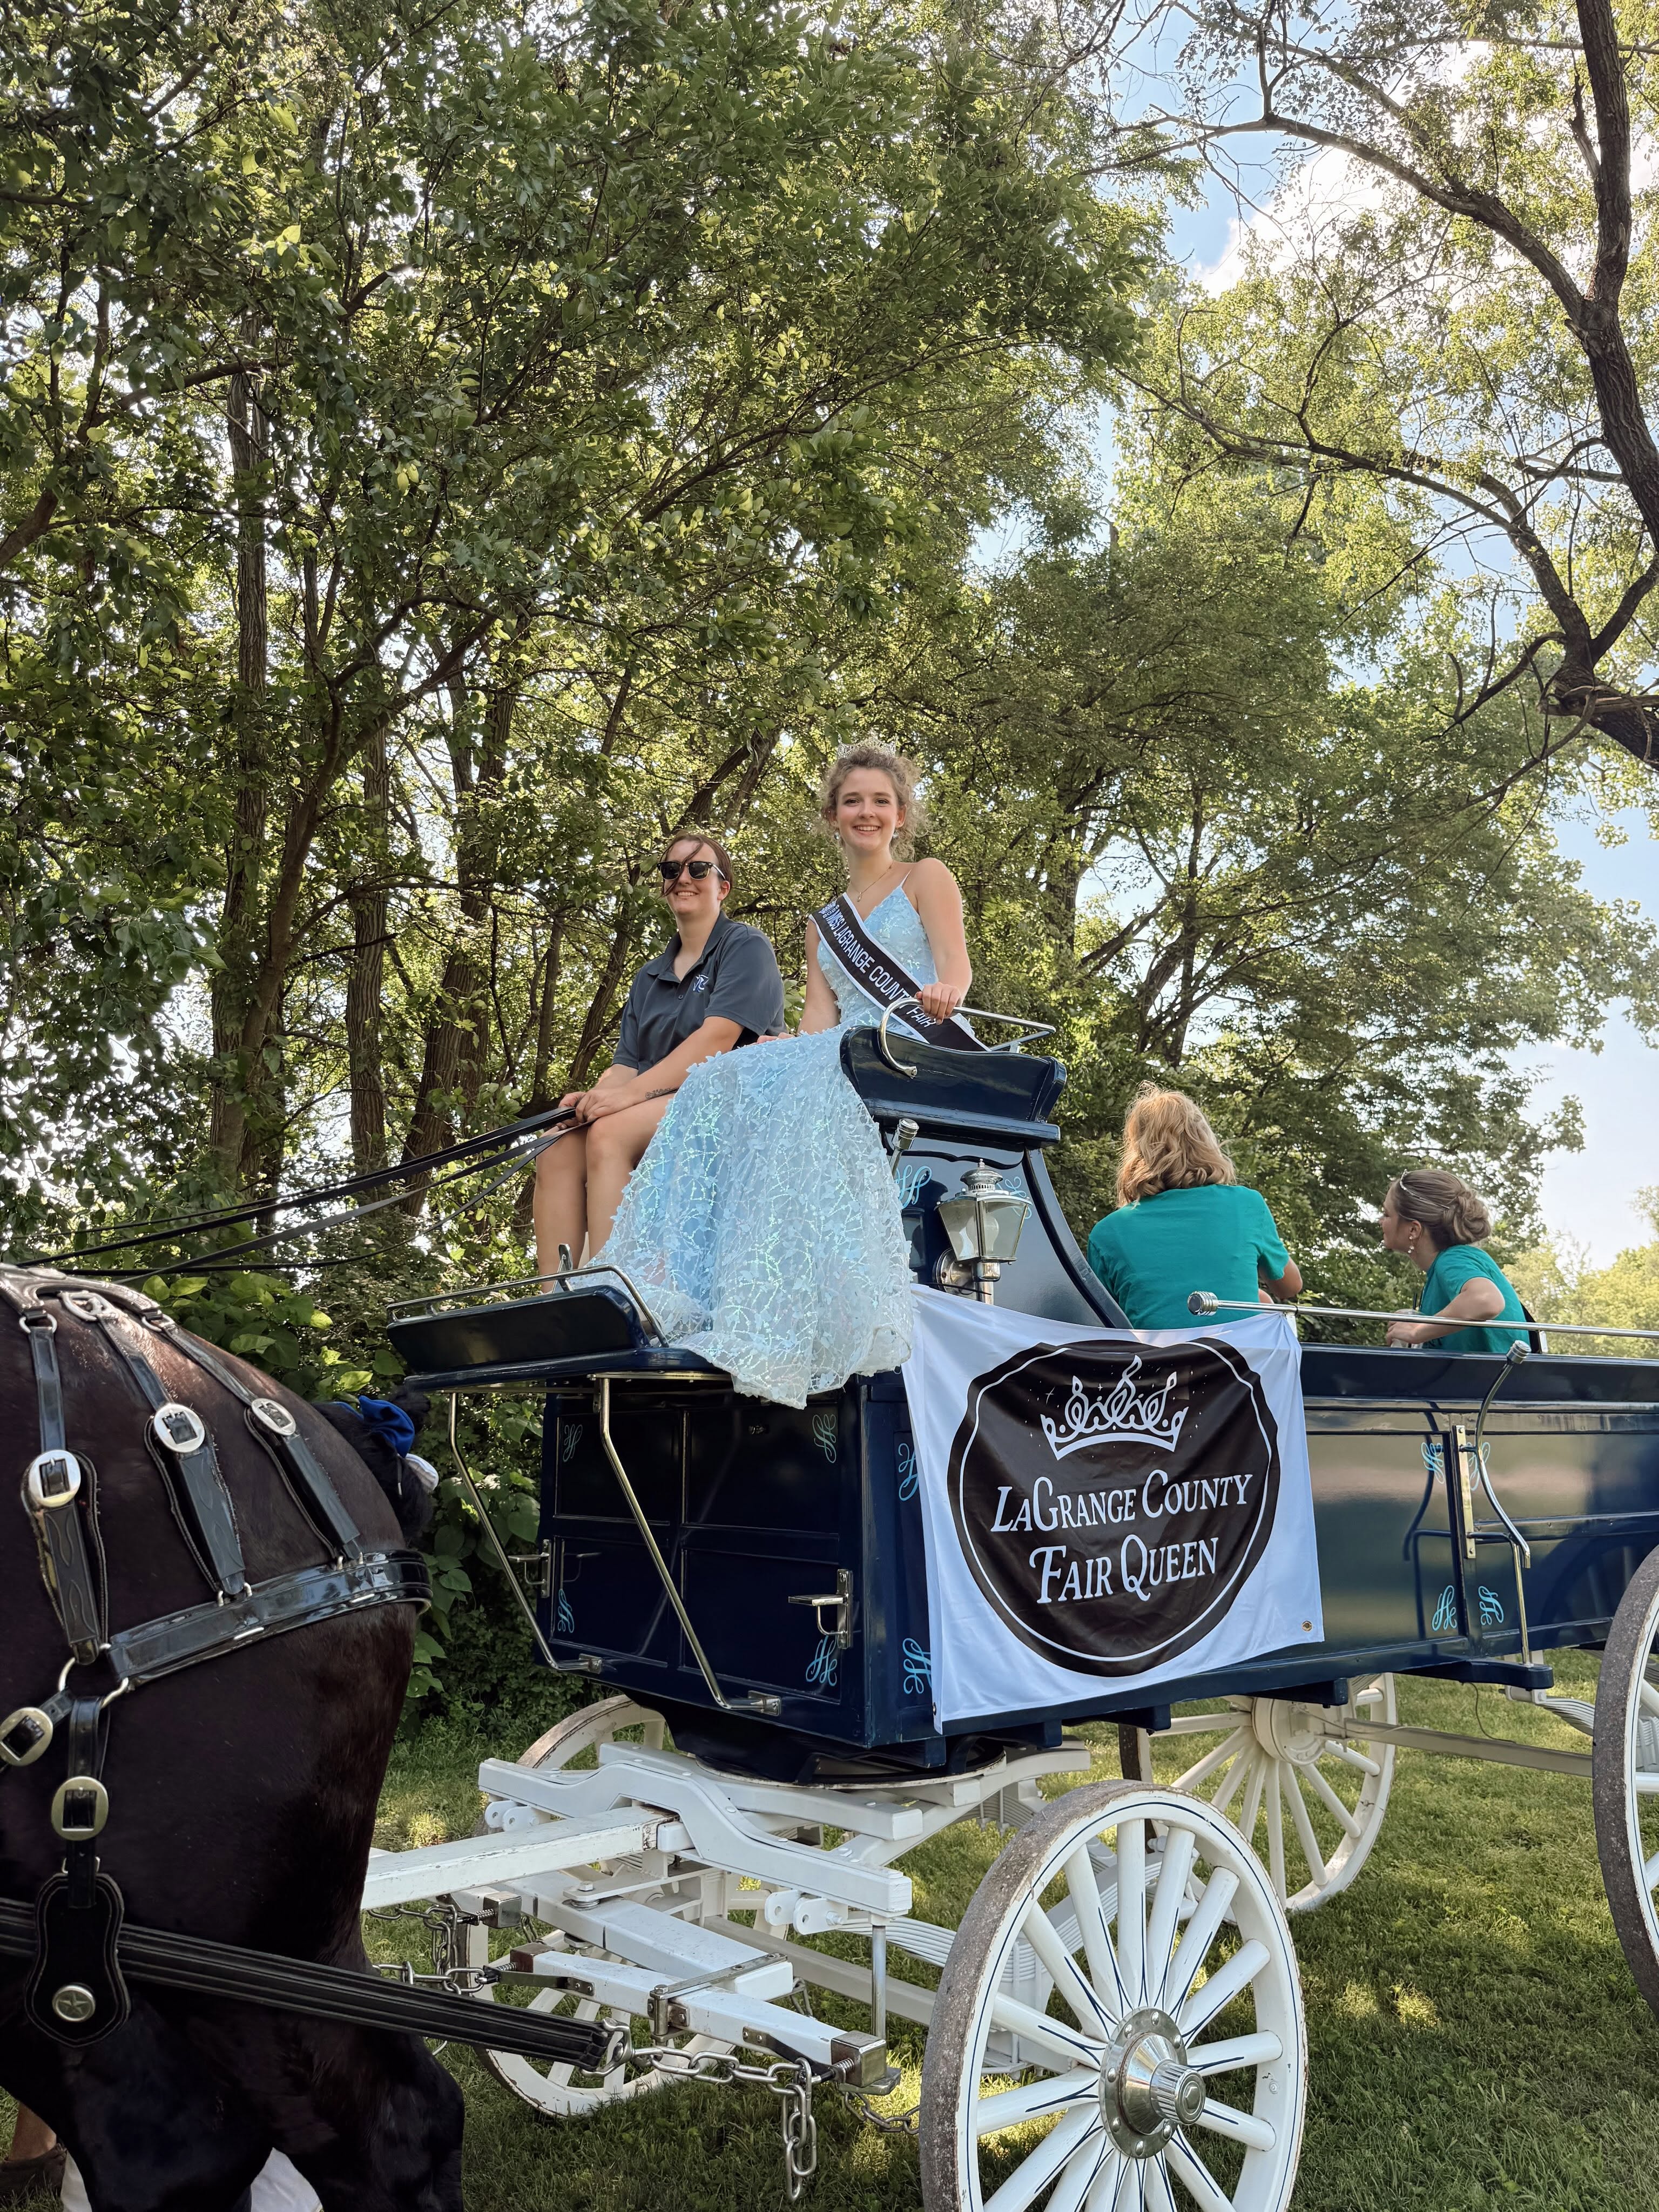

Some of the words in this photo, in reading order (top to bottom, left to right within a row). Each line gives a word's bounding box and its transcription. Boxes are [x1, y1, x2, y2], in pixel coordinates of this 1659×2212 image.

[833, 921, 875, 974] LAGRANGE
[1142, 1469, 1253, 1518] COUNTY
[1029, 1545, 1114, 1604] FAIR
[1121, 1534, 1219, 1602] QUEEN
